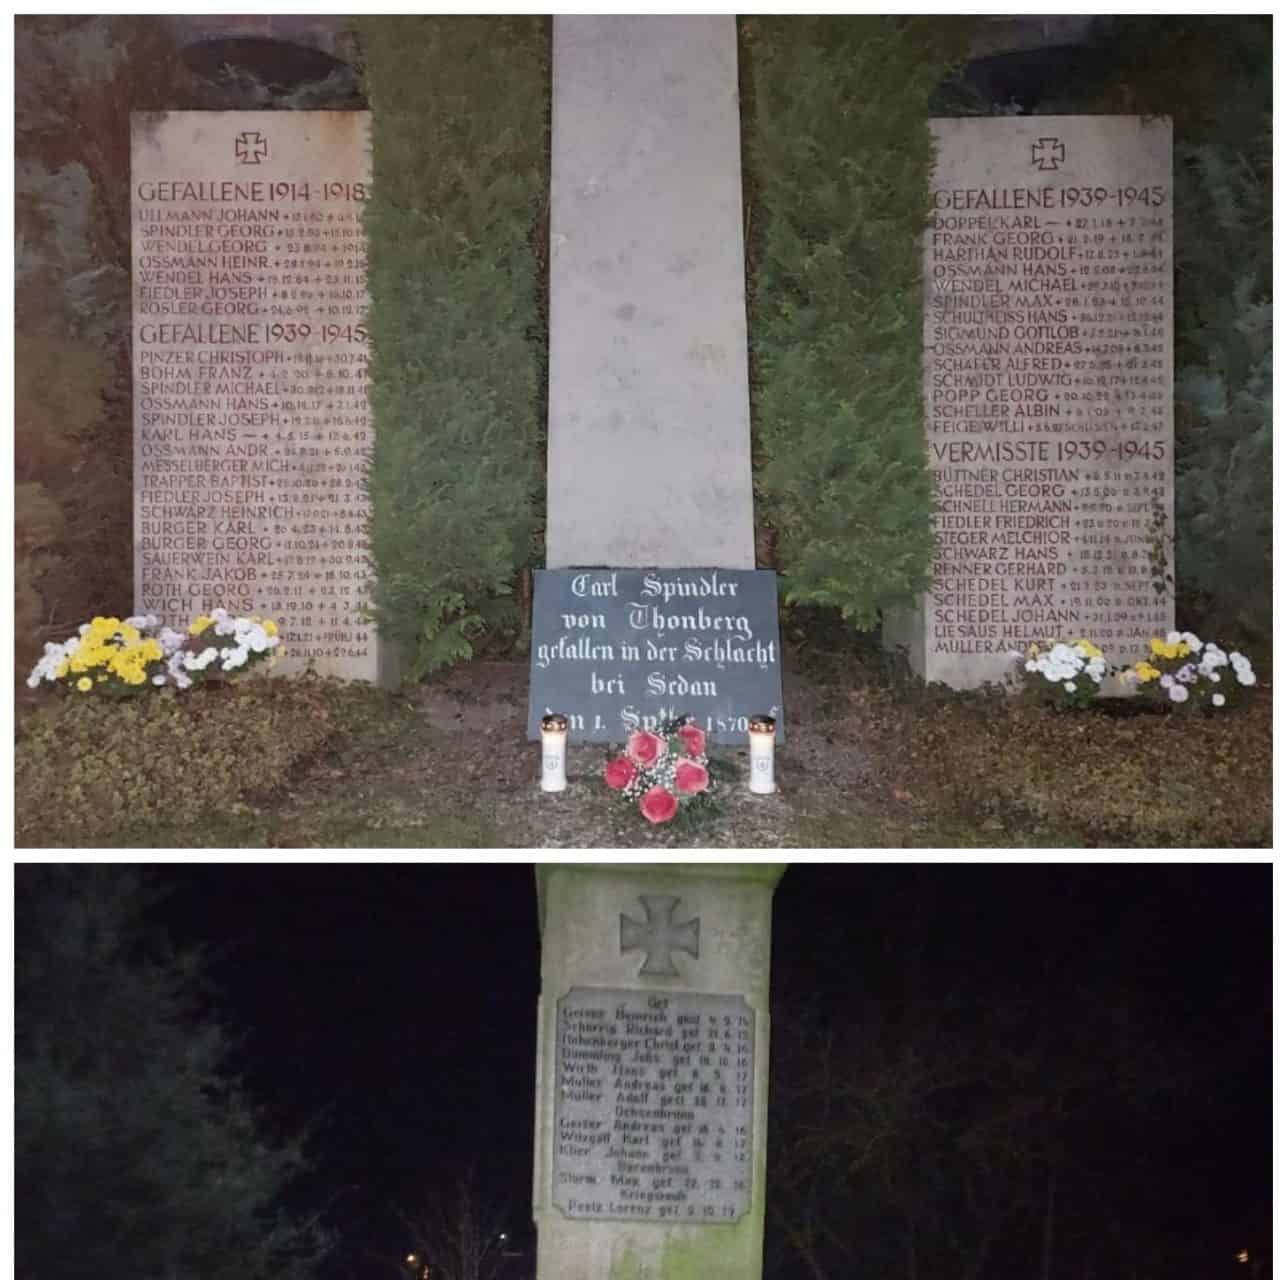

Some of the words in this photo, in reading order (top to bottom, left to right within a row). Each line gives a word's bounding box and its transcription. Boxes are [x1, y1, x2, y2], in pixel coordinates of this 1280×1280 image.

[137, 181, 264, 202] GEFALLENE
[933, 189, 1055, 210] GEFALLENE
[217, 209, 279, 221] JOHANN
[1013, 247, 1076, 261] RUDOLF
[1024, 263, 1066, 277] HANS
[210, 272, 251, 284] HANS
[1008, 279, 1077, 292] MICHAEL
[205, 287, 267, 300] JOSEPH
[140, 323, 260, 344] GEFALLENE
[1015, 342, 1081, 355] ANDREAS
[199, 352, 284, 363] CHRISTOPH
[200, 367, 252, 379] FRANZ
[933, 389, 980, 402] POPP
[226, 398, 269, 411] HANS
[1015, 405, 1059, 417] ALBIN
[142, 413, 216, 425] SPINDLER
[188, 429, 236, 441] HANS
[932, 441, 1049, 462] VERMISSTE
[1003, 468, 1079, 482] CHRISTIAN
[203, 490, 264, 503] JOSEPH
[1006, 485, 1064, 497] GEORG
[214, 521, 256, 534] KARL
[995, 516, 1070, 529] FRIEDRICH
[212, 537, 272, 550] GEORG
[237, 552, 275, 565] KARL
[1015, 548, 1058, 560] HANS
[202, 567, 257, 580] JAKOB
[995, 562, 1066, 575] GERHARD
[571, 575, 618, 597] Carl
[641, 572, 738, 602] Spindler
[1014, 579, 1055, 592] KURT
[143, 599, 193, 612] WICH
[202, 599, 254, 612] HANS
[1014, 594, 1054, 607] MAX
[561, 614, 606, 629] von
[625, 602, 753, 640] Thonberg
[935, 609, 1008, 622] SCHEDEL
[1012, 609, 1079, 622] JOHANN
[1003, 625, 1062, 637] HELMUT
[536, 636, 614, 668] gefallen
[621, 640, 640, 660] in
[647, 641, 677, 661] der
[683, 638, 775, 671] Schlacht
[591, 672, 624, 694] bei
[647, 671, 717, 696] Sedan
